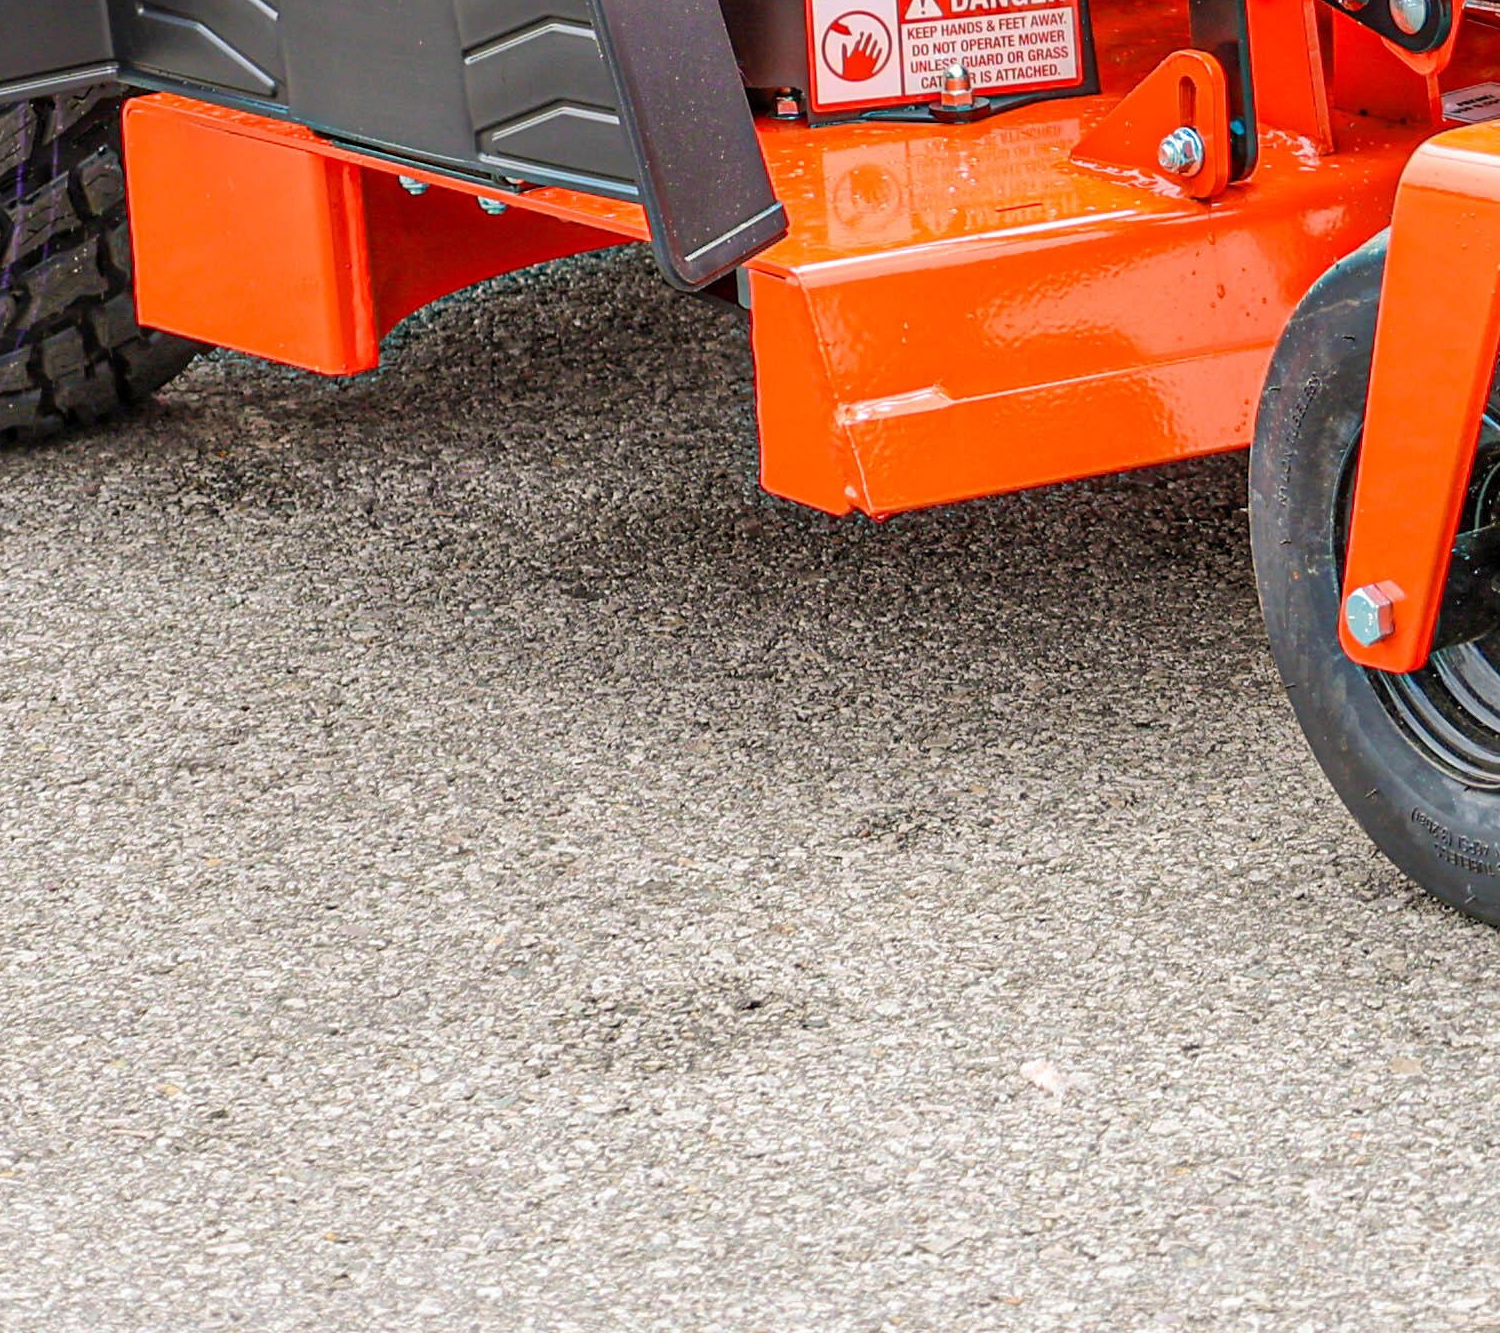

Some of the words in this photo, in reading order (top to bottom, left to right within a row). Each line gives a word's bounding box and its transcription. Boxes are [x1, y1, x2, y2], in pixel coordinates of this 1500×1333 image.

[907, 26, 937, 40] KEEP
[941, 21, 983, 37] HANDS
[986, 20, 995, 32] &
[999, 16, 1027, 30] FEET
[1030, 12, 1067, 28] AWAY.
[912, 44, 929, 57] DO
[933, 41, 956, 55] NOT
[960, 34, 1015, 52] OPERATE
[1018, 30, 1065, 46] MOWER
[910, 57, 958, 74] UNLESS
[961, 53, 1004, 68] GUARD
[1007, 51, 1024, 64] OR
[1028, 46, 1069, 62] GRASS
[920, 71, 977, 90] CATR
[980, 71, 992, 83] IS
[995, 63, 1061, 82] ATTACHED.
